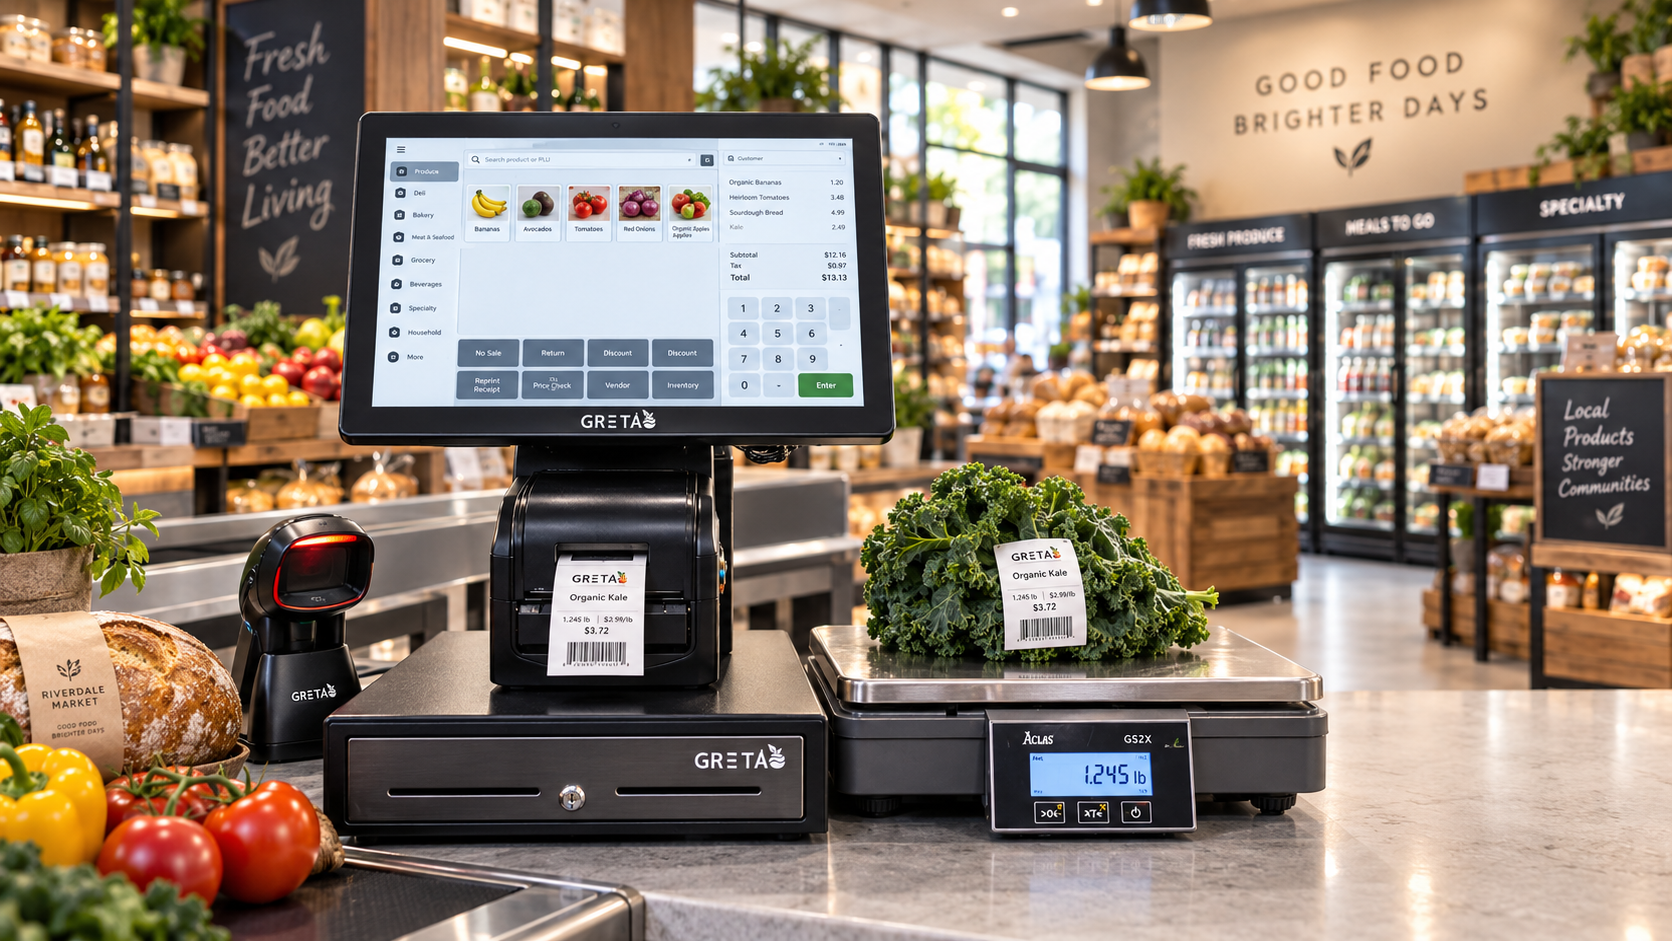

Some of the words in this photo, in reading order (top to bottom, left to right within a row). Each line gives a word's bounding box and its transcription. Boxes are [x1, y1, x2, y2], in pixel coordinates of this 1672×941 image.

[243, 20, 331, 82] Fresh
[1255, 67, 1346, 96] GOOD
[1369, 51, 1463, 84] FOOD
[245, 73, 314, 128] Food
[1234, 100, 1384, 136] BRIGHTER
[1405, 88, 1488, 119] DAYS
[242, 127, 330, 177] Better
[241, 177, 336, 231] Living
[1539, 192, 1625, 218] SPECIALTY
[1346, 216, 1390, 236] MEALS
[1390, 214, 1410, 232] TO
[1412, 212, 1435, 229] GO
[1188, 232, 1225, 249] FRESH
[1227, 226, 1285, 246] PRODUCE
[741, 381, 748, 389] 0
[1564, 396, 1610, 421] Local
[580, 413, 642, 429] GRETA
[1563, 424, 1635, 448] Products
[1561, 453, 1624, 477] Stronger
[1558, 474, 1651, 498] Communities
[1012, 551, 1052, 561] GRETA
[572, 575, 617, 583] GRETA
[1013, 571, 1046, 580] Organic
[570, 594, 605, 602] Organic
[1033, 603, 1056, 612] $3.72
[41, 685, 105, 699] RIVERDALE
[292, 688, 328, 702] GRETA
[52, 697, 97, 709] MARKET
[1124, 735, 1152, 743] GS2X
[694, 749, 768, 769] GRETA
[1085, 764, 1128, 784] 1.245
[1134, 771, 1146, 784] lb
